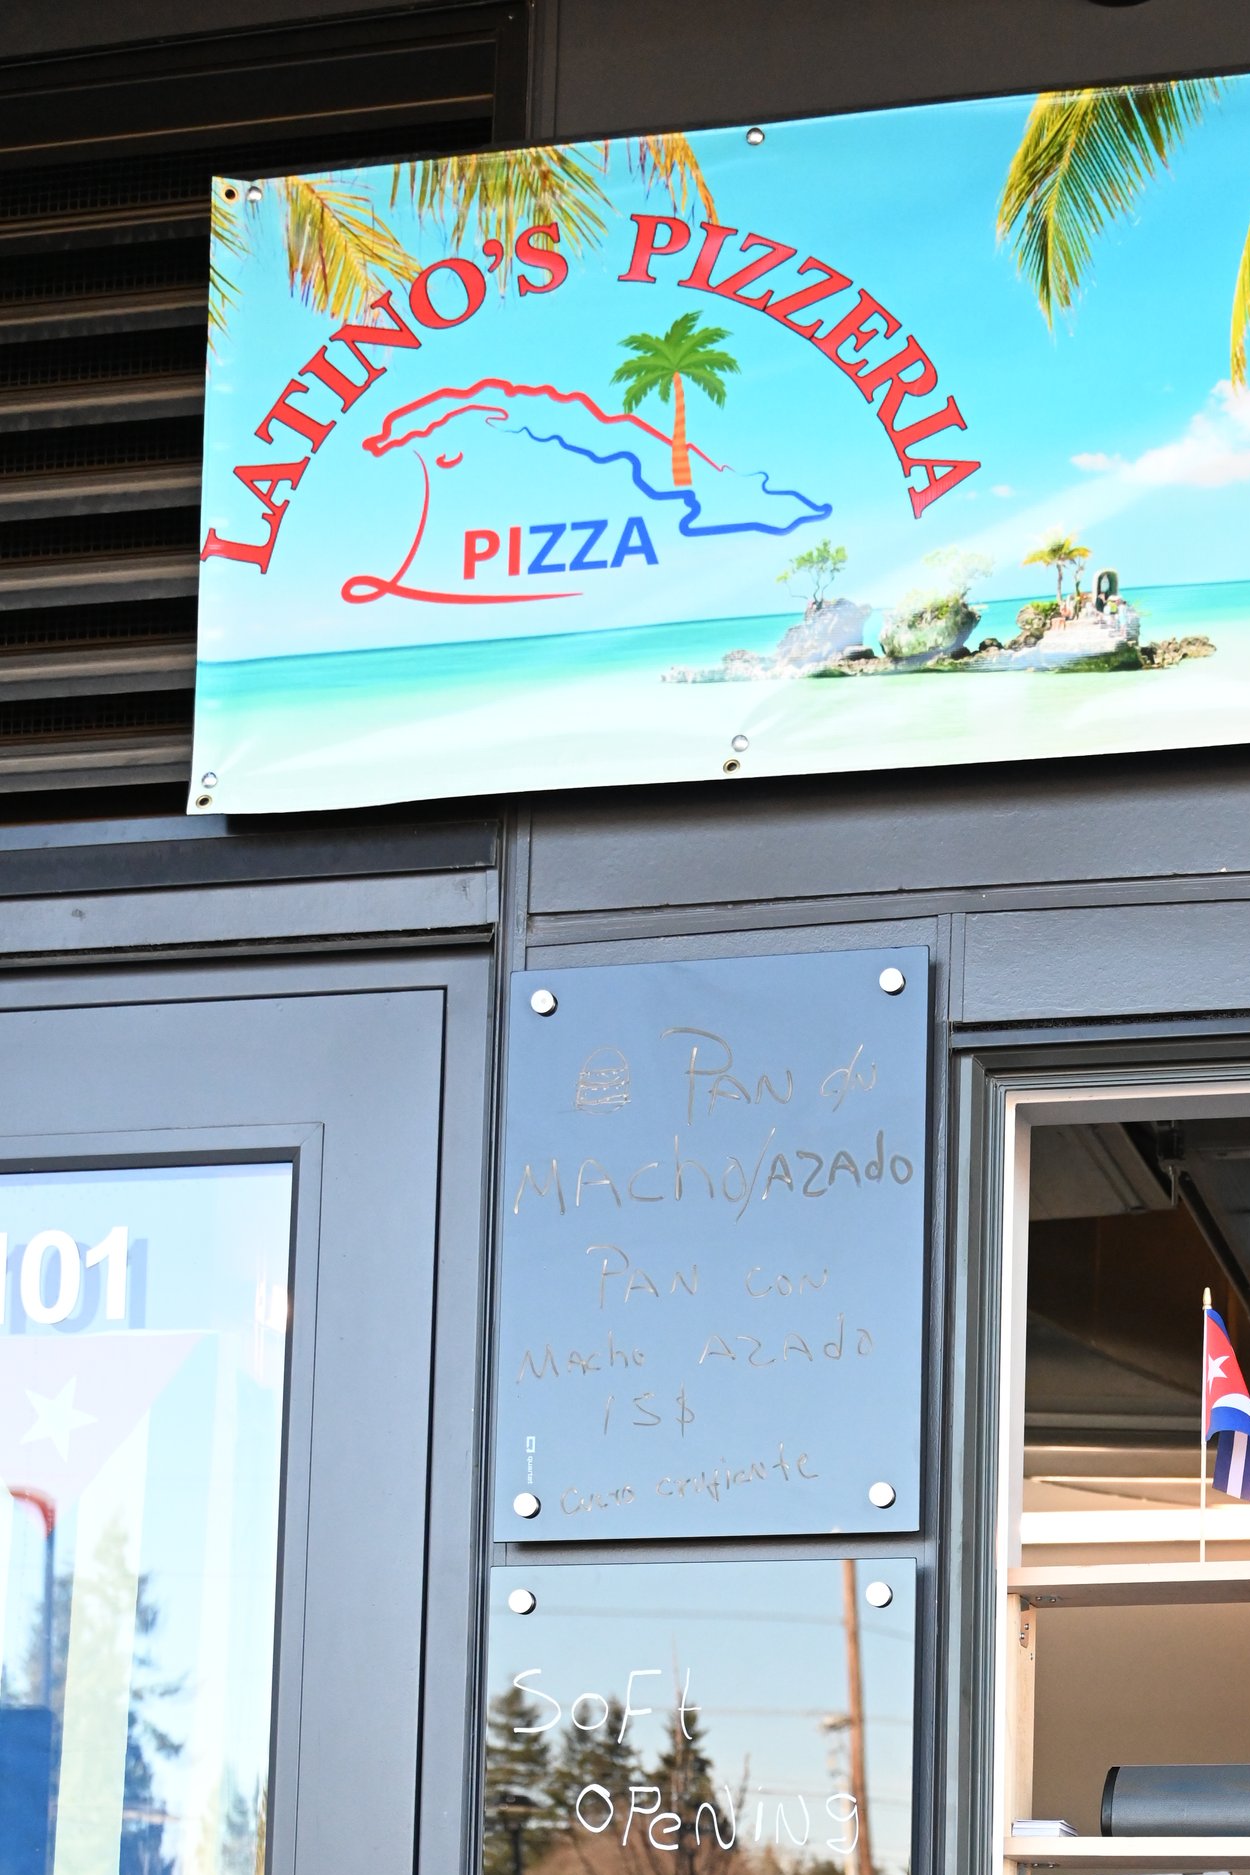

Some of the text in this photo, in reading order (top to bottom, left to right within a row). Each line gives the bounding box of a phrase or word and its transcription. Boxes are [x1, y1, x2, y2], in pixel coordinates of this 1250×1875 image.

[200, 213, 982, 575] LATINO'S PIZZERIA
[462, 516, 660, 581] PIZZA
[586, 1244, 829, 1309] PAN CON
